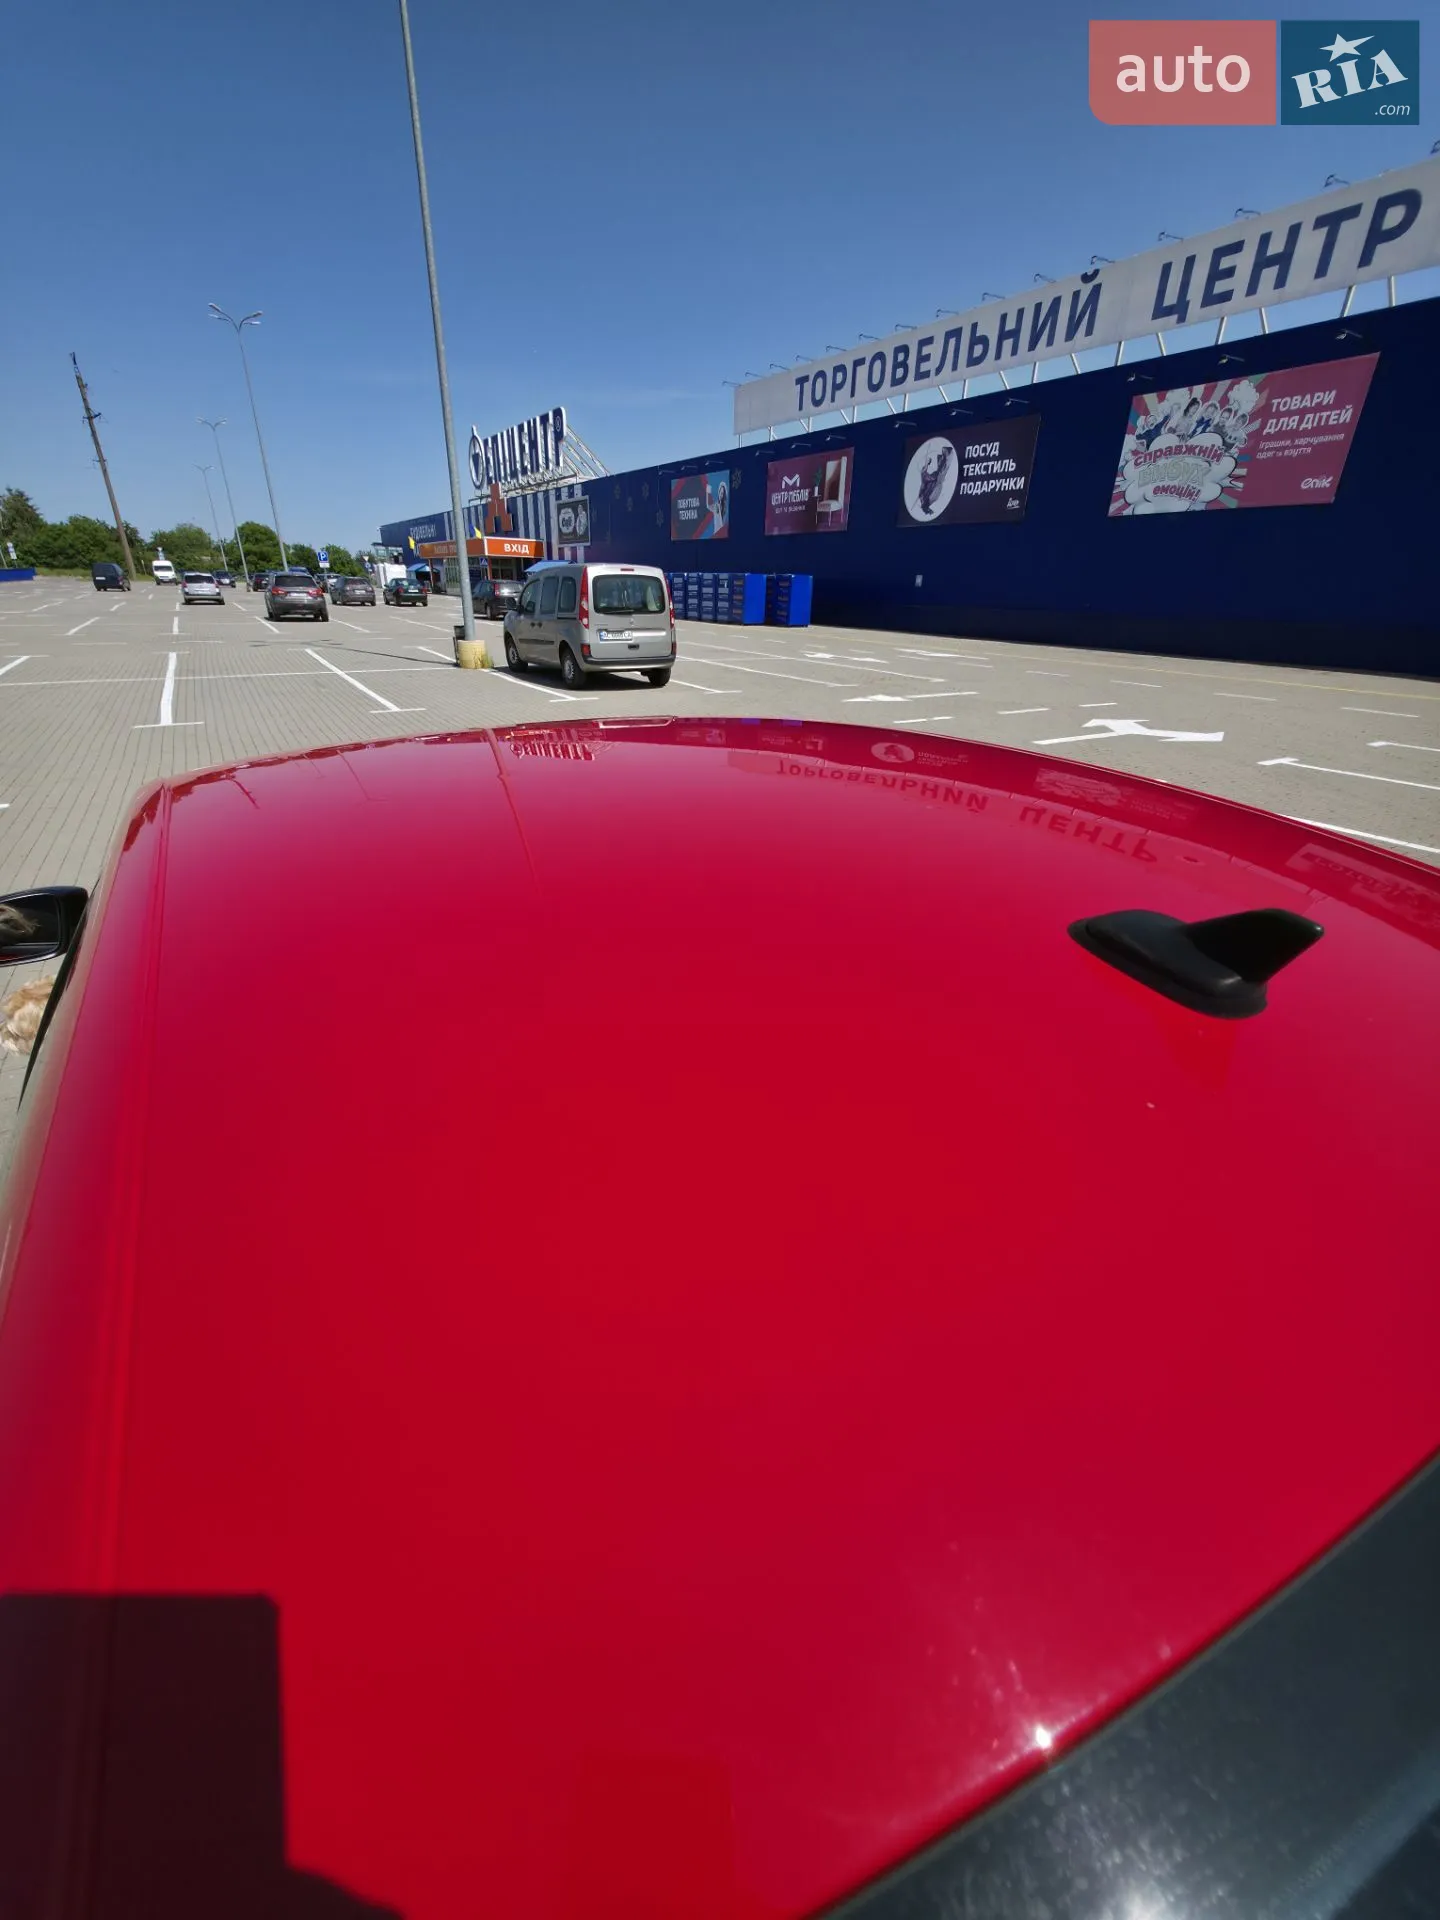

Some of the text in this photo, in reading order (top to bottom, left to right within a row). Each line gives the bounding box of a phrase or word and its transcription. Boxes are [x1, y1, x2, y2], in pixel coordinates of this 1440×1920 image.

[795, 188, 1423, 412] ТОРГОВЕЛЬНИЙ ЦЕНТР
[1271, 389, 1337, 413] ТОВАРИ
[1263, 404, 1354, 436] ДЛЯ ДІТЕЙ
[483, 407, 567, 485] ЕПІЦЕНТР
[965, 441, 1000, 459] ПОСУД
[963, 458, 1017, 477] ТЕКСТИЛЬ
[960, 476, 1025, 495] ПОДАРУНКИ
[503, 543, 530, 554] ВХІД
